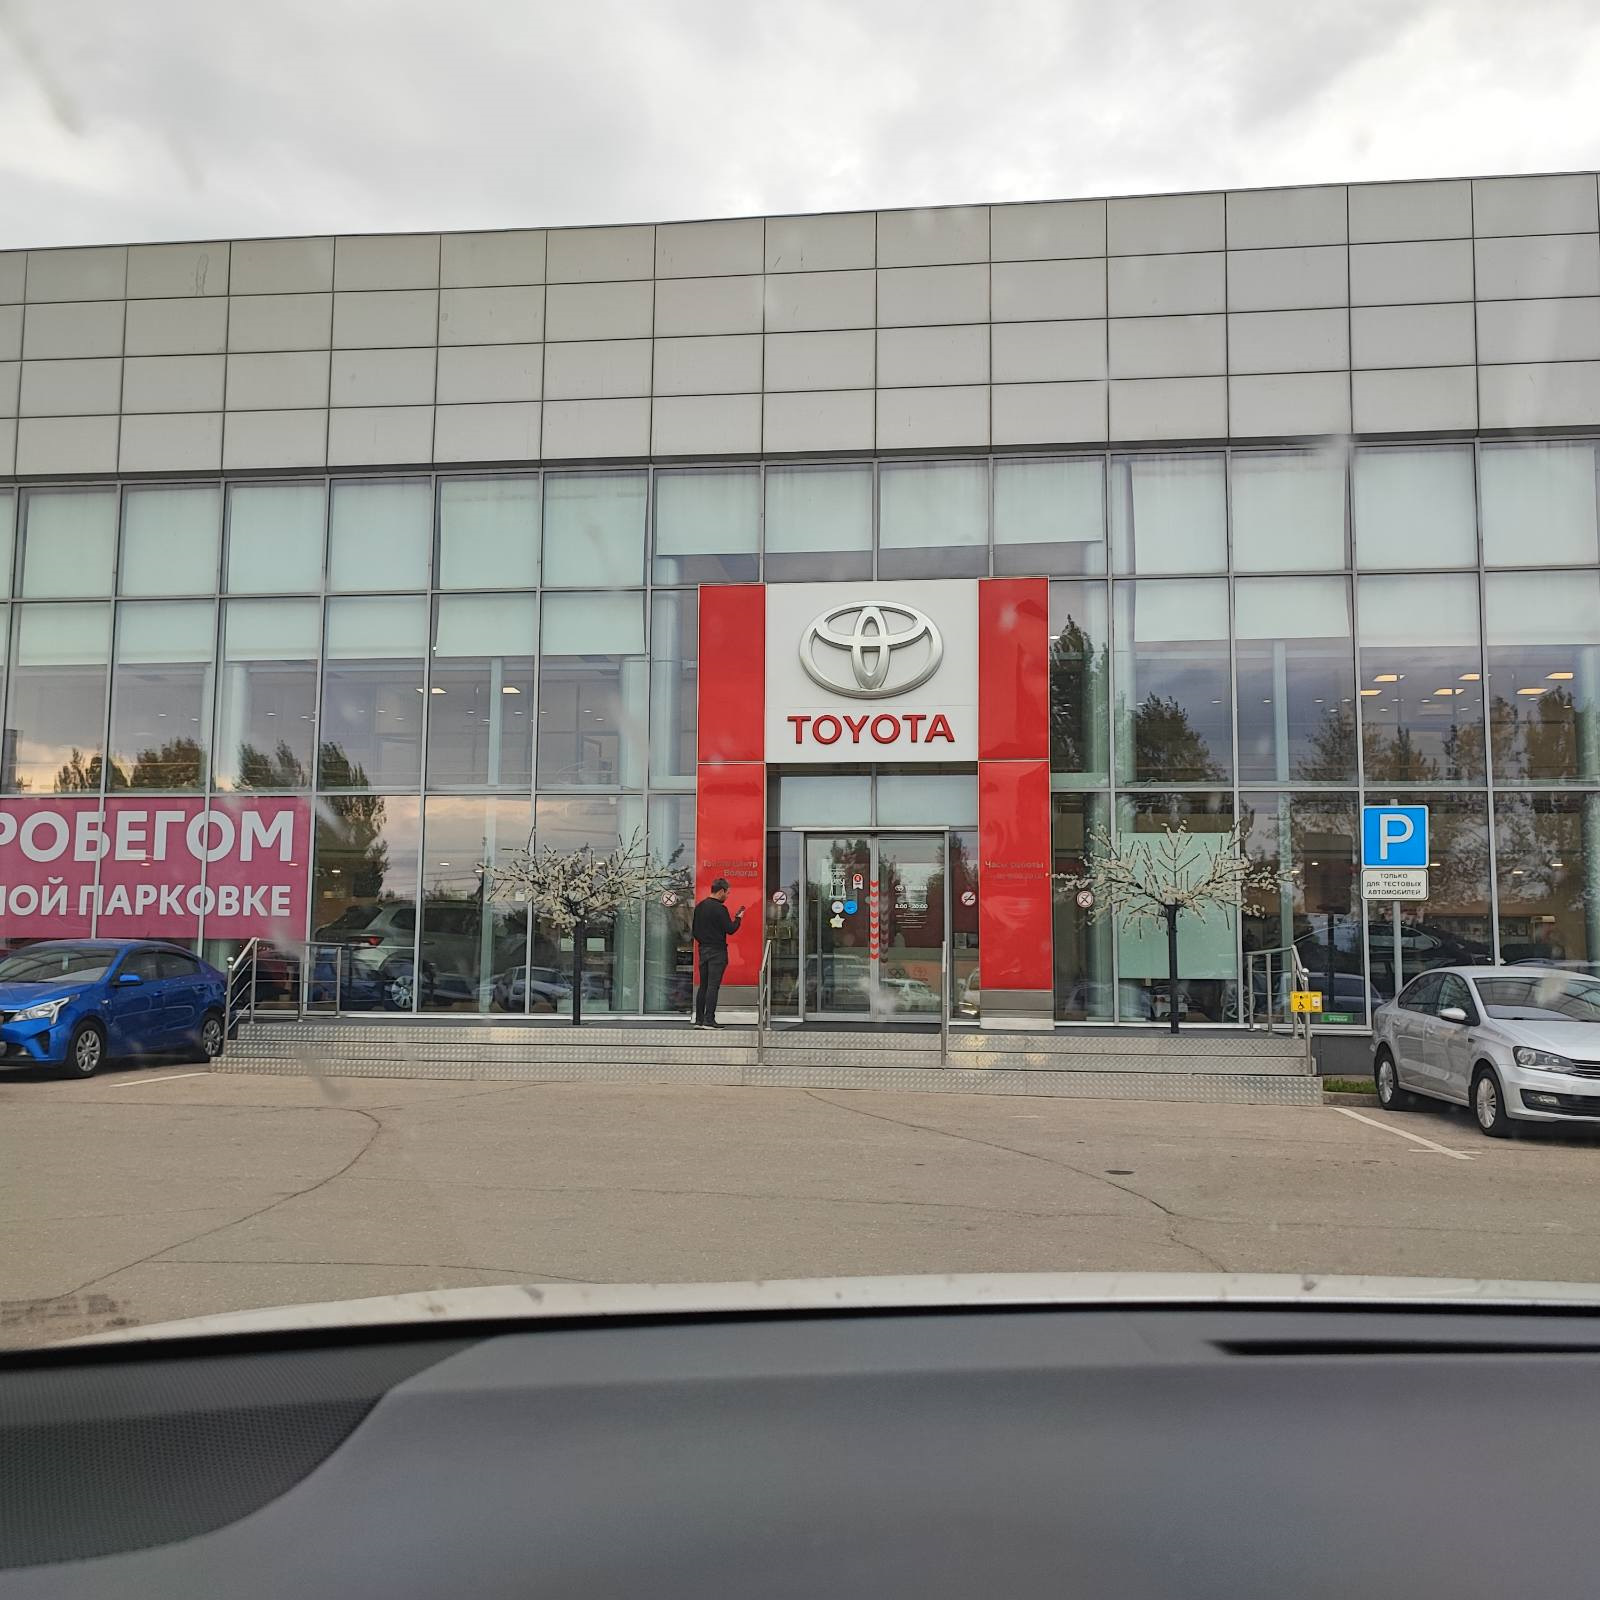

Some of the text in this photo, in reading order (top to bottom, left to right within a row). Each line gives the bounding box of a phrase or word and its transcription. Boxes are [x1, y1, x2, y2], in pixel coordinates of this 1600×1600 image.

[787, 713, 956, 745] TOYOTA
[1380, 814, 1414, 860] P
[0, 876, 291, 917] ОЙ ПАРКОВКЕ
